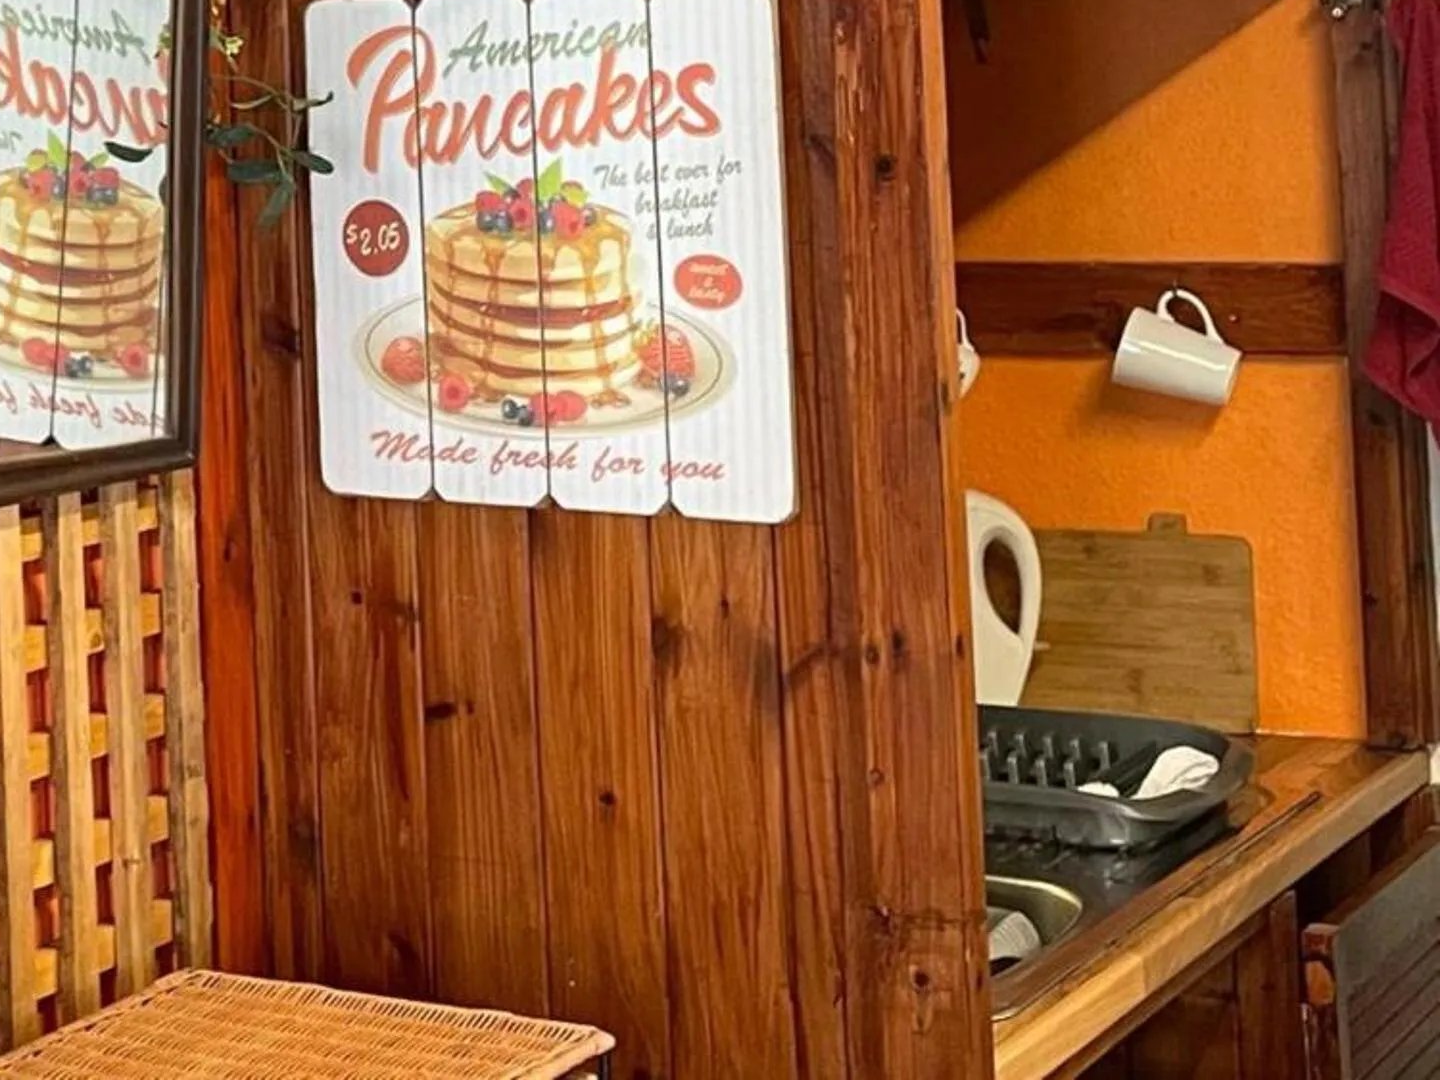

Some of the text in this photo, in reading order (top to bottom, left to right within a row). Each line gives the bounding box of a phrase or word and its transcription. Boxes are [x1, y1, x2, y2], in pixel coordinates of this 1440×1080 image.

[442, 19, 652, 78] American
[346, 25, 722, 174] Pancakes
[593, 164, 627, 190] The
[716, 154, 742, 184] for
[666, 212, 714, 240] lunch
[370, 429, 725, 486] Made fresh for you
